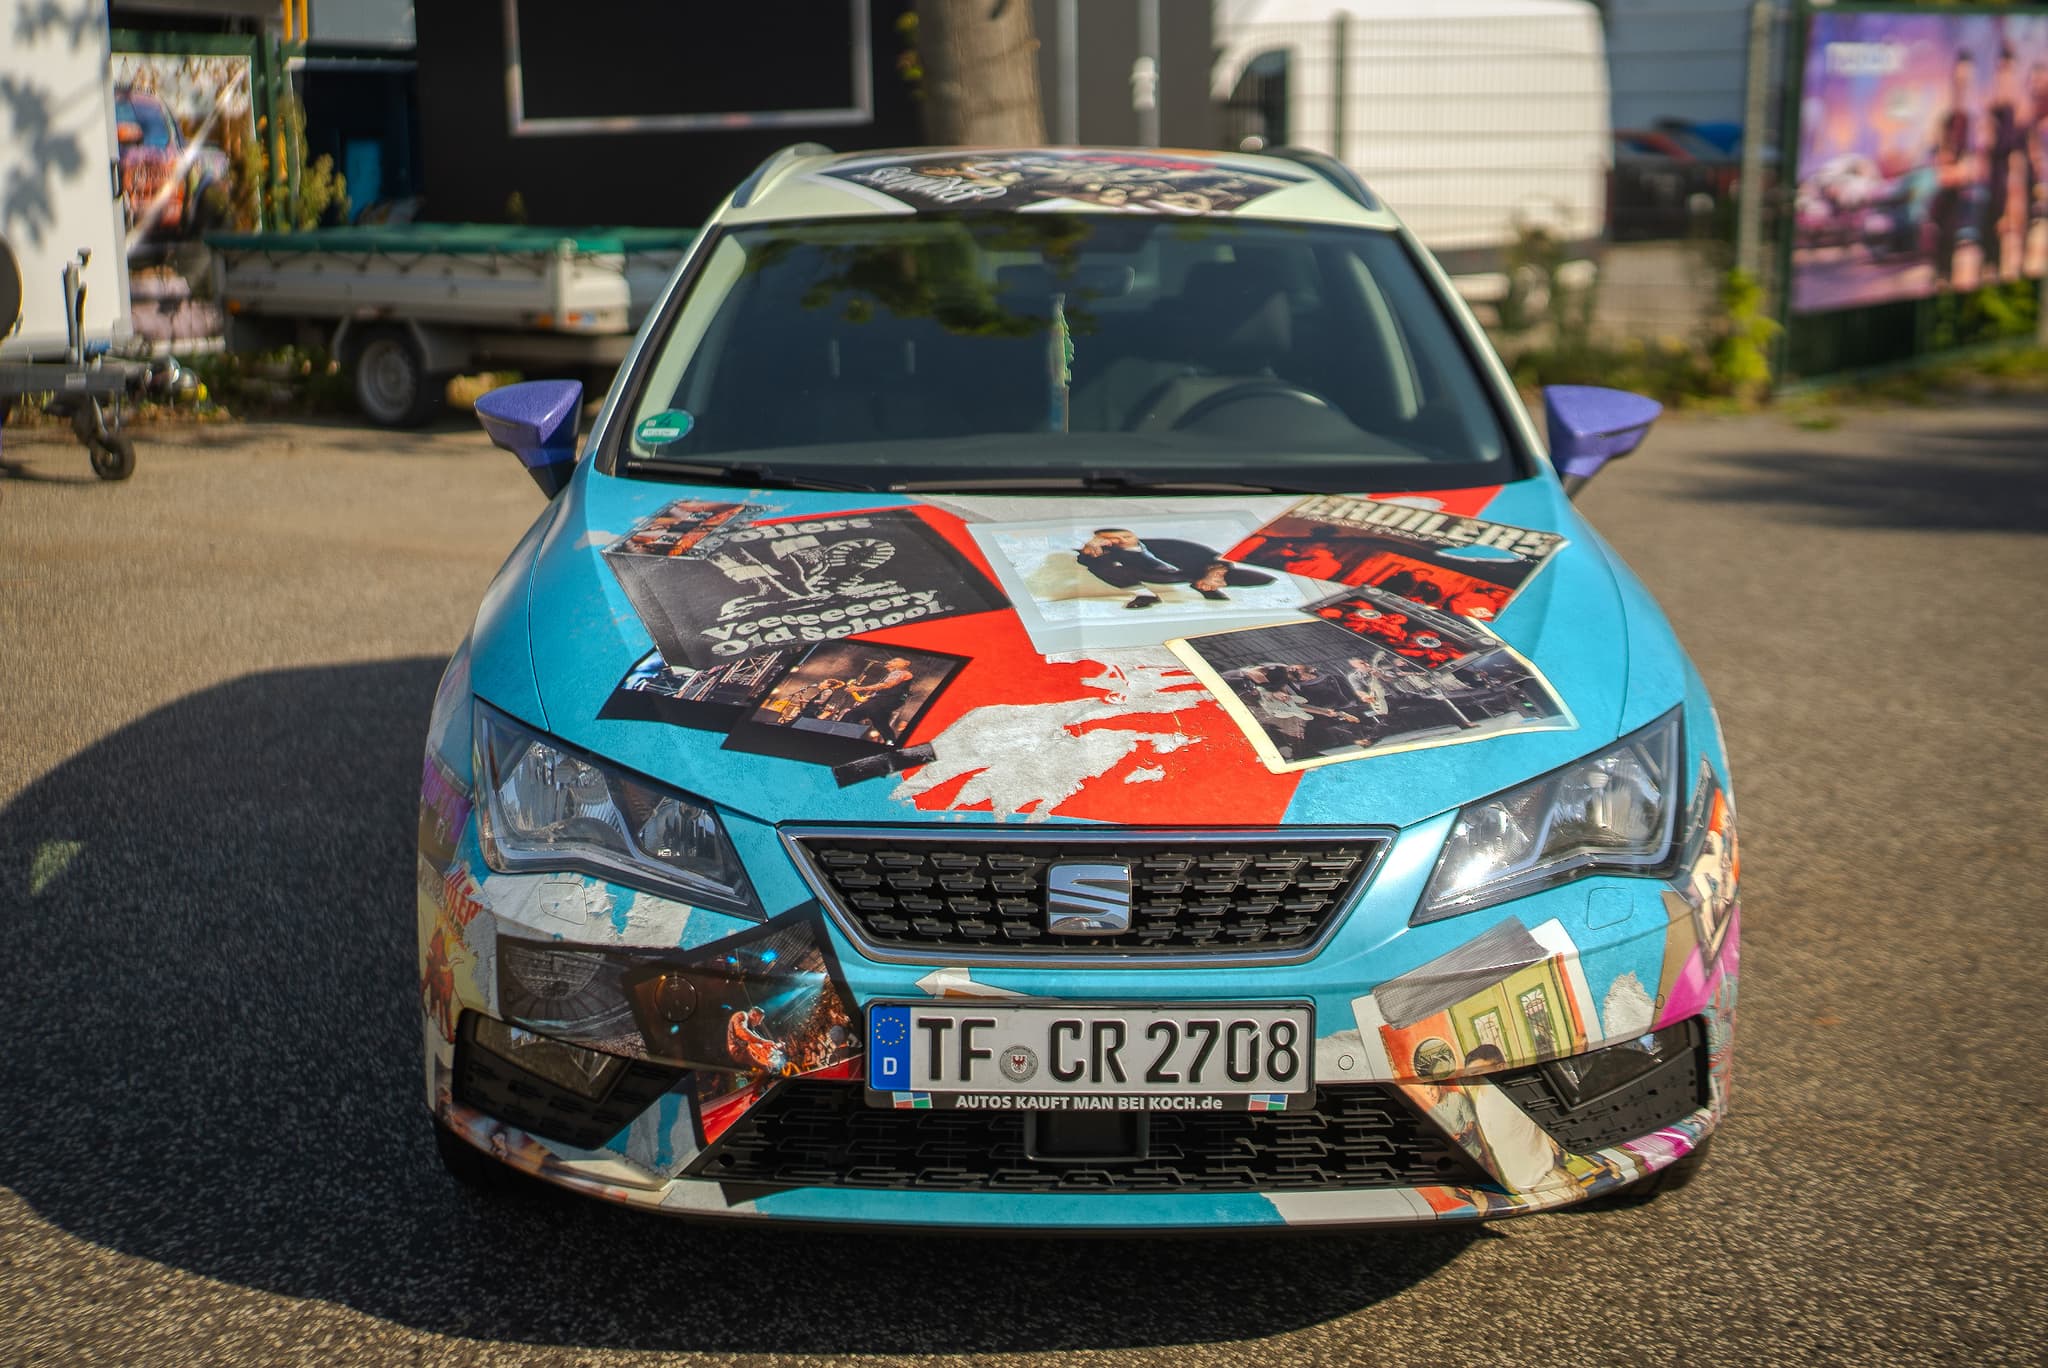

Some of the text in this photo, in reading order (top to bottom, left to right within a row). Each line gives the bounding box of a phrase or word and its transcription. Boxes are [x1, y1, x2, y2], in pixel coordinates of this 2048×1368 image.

[1291, 494, 1564, 558] BROILERS
[711, 625, 797, 657] Old
[882, 1056, 898, 1076] D
[917, 1016, 997, 1082] TF
[1048, 1018, 1129, 1084] CR
[1145, 1018, 1300, 1084] 2708
[955, 1095, 1223, 1110] AUTOS KAUFT MAN BEI KOCH.de
